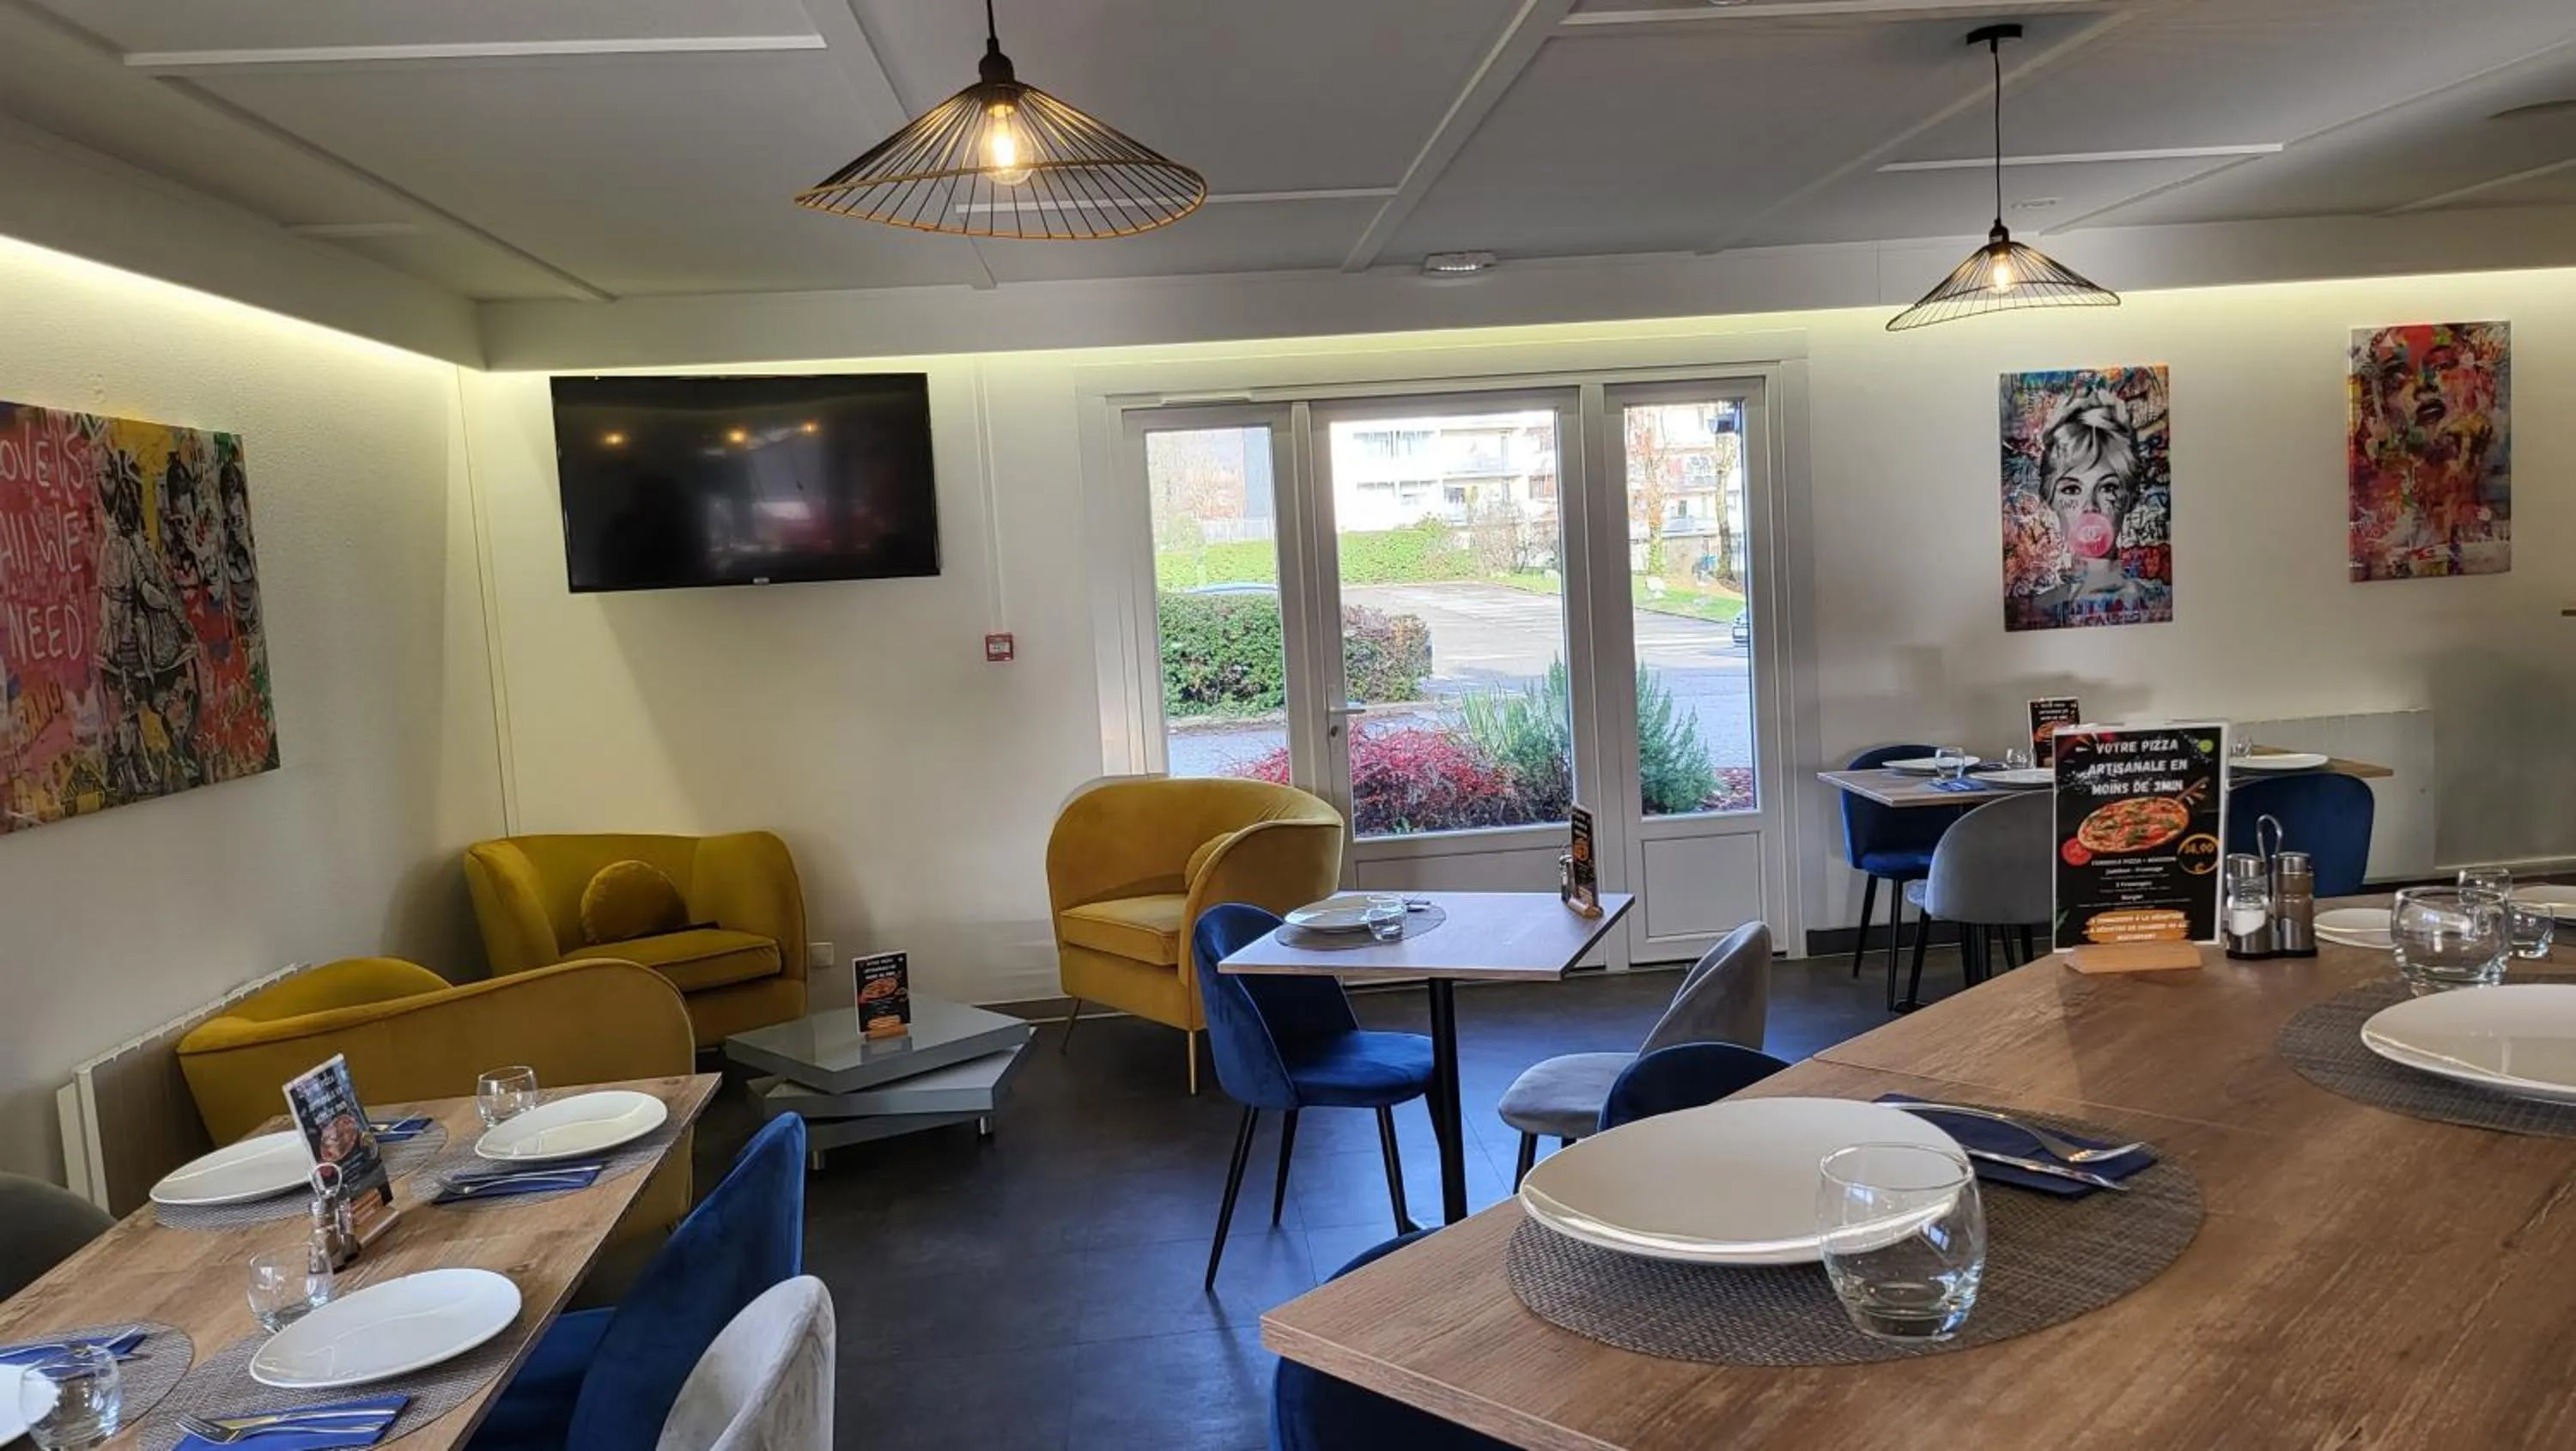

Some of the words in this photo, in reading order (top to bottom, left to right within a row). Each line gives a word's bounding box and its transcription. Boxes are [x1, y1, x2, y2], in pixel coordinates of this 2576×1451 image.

[0, 421, 50, 488] OVE
[7, 601, 82, 666] NEED
[2095, 741, 2137, 755] VOTRE
[2141, 739, 2179, 752] PIZZA
[2087, 760, 2166, 775] ARTISANALE
[2170, 758, 2189, 771] EN
[2091, 782, 2129, 795] MOINS
[2132, 780, 2150, 792] DE
